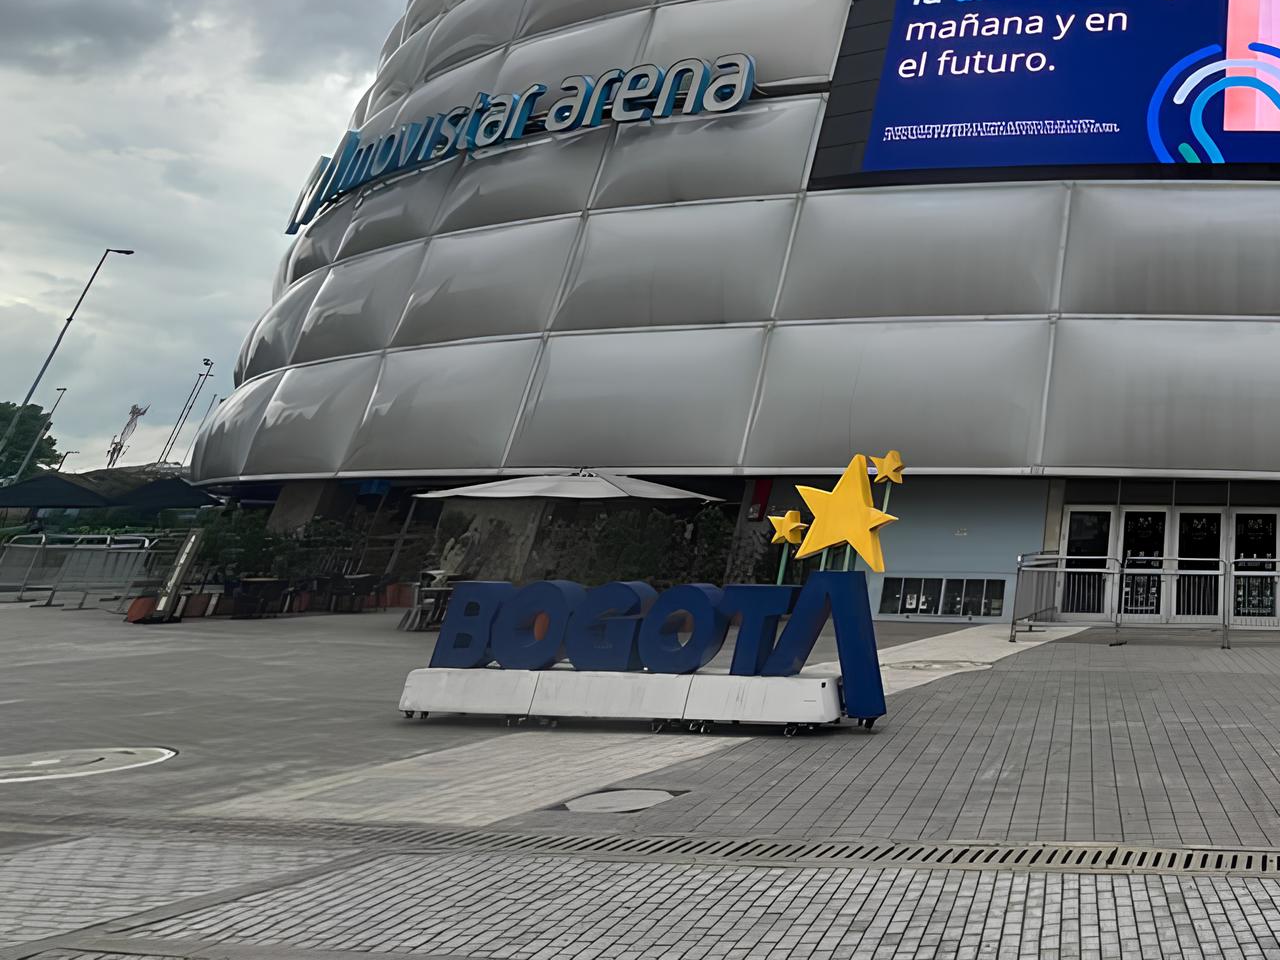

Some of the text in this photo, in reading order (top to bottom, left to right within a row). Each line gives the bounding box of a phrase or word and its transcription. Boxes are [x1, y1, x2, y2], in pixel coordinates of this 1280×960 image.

[906, 13, 1127, 40] mañana y en
[899, 50, 1055, 78] el futuro.
[318, 52, 757, 202] movistar arena
